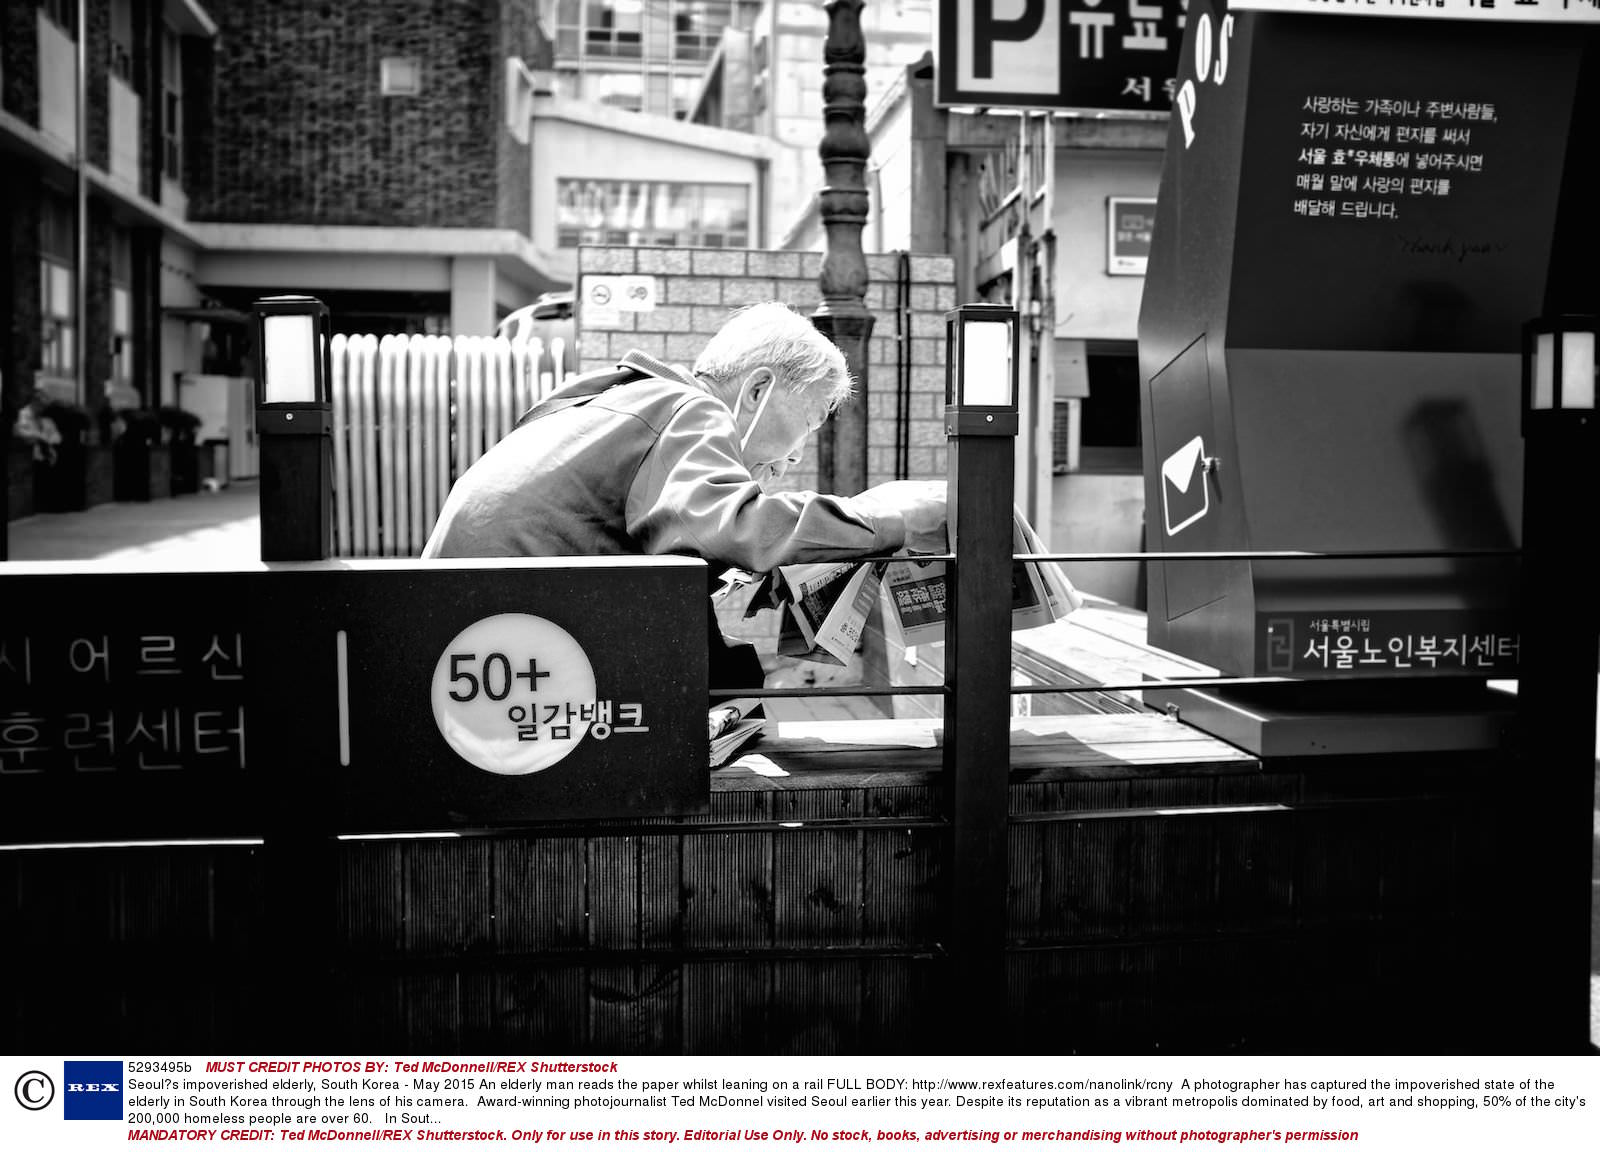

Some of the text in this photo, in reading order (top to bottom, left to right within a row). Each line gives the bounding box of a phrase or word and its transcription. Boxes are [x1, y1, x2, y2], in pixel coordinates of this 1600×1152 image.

[1068, 0, 1188, 59] 유료
[1302, 96, 1498, 123] 사랑하는 가족이나 주변사람들,
[1300, 122, 1472, 146] 자기 자신에게 편지를 써서
[1298, 148, 1327, 165] 서울
[1415, 152, 1484, 172] 넣어주시면
[1296, 173, 1451, 196] 매월 말에 사랑의 편지를
[1293, 199, 1399, 219] 배달해 드립니다.
[1309, 618, 1371, 633] 서울특별시립
[1303, 634, 1521, 669] 서울노인복지센터
[447, 652, 551, 702] 50+
[507, 700, 651, 742] 일감뱅크
